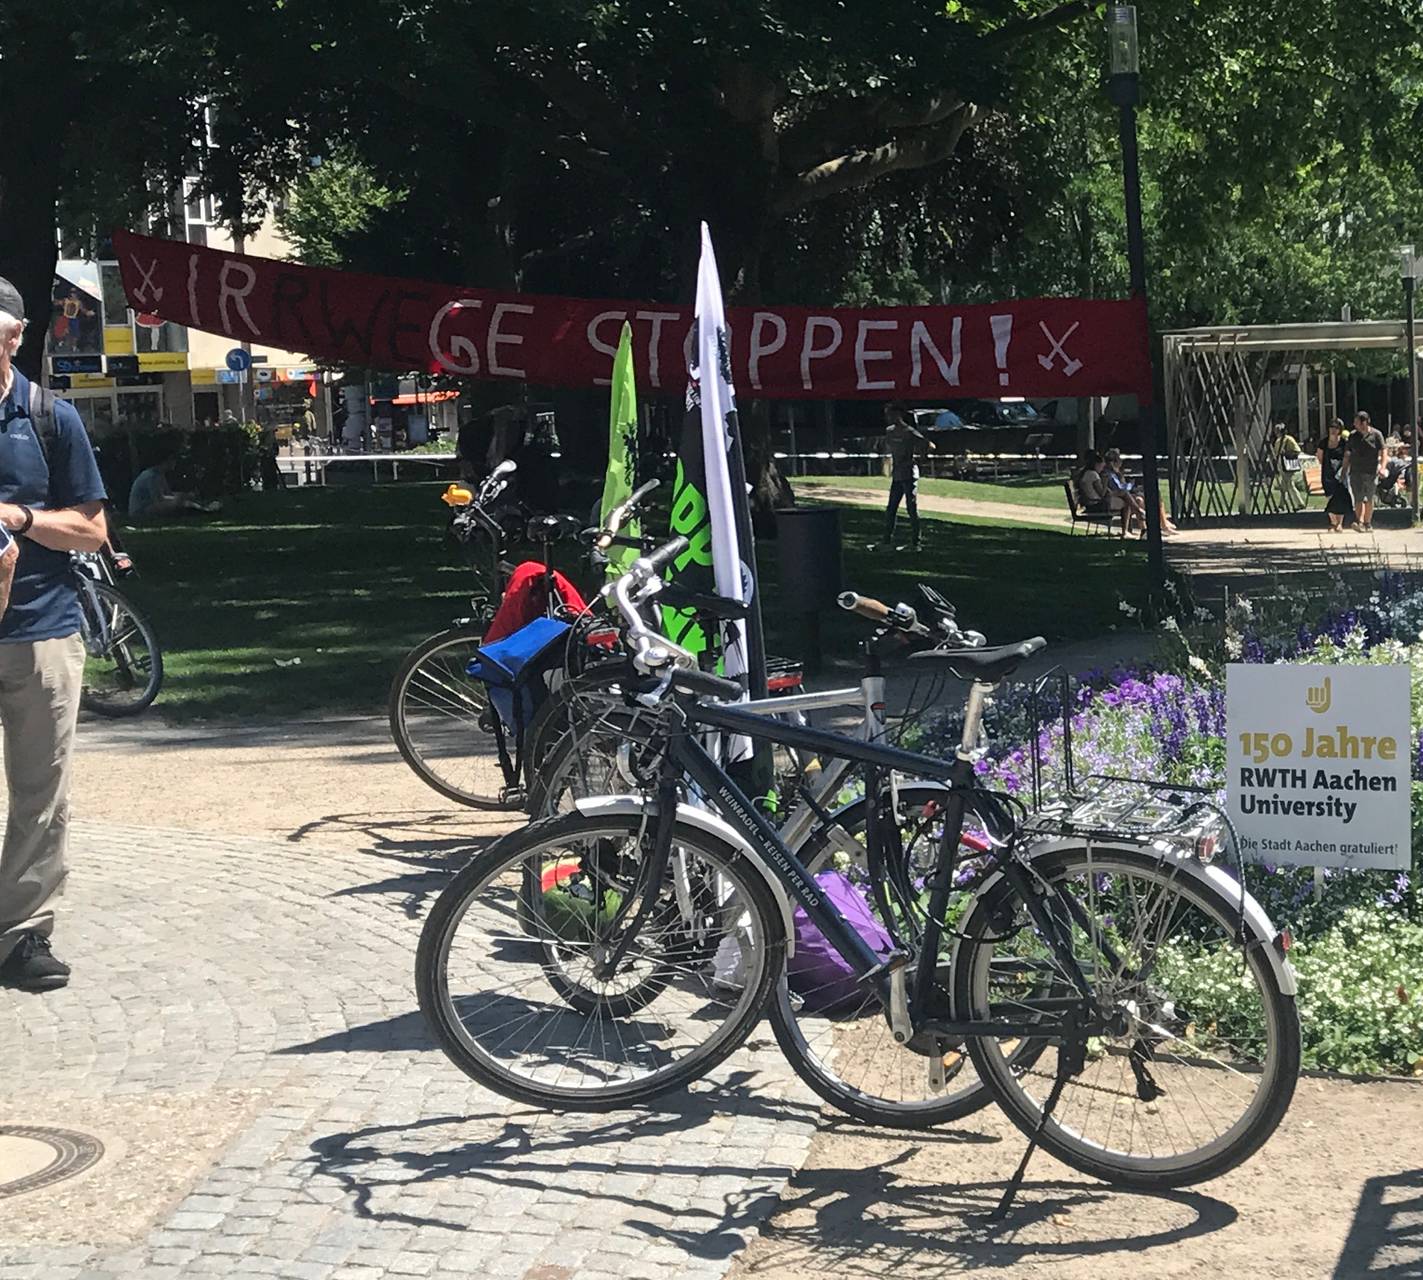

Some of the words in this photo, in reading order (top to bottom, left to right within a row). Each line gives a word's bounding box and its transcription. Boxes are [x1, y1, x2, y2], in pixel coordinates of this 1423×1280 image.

[187, 253, 535, 379] IRRWEGE
[1239, 731, 1293, 764] 150
[1301, 725, 1398, 760] Jahre
[1240, 767, 1307, 789] RWTH
[1312, 769, 1397, 791] Aachen
[1240, 793, 1358, 823] University
[719, 786, 761, 836] WEINRADEL
[763, 840, 792, 872] REISEN
[787, 870, 805, 889] PER
[801, 888, 820, 907] RAD
[1239, 837, 1258, 850] Die
[1261, 838, 1291, 851] Stadt
[1294, 840, 1337, 853] Aachen
[1339, 842, 1399, 856] gratuliert!
